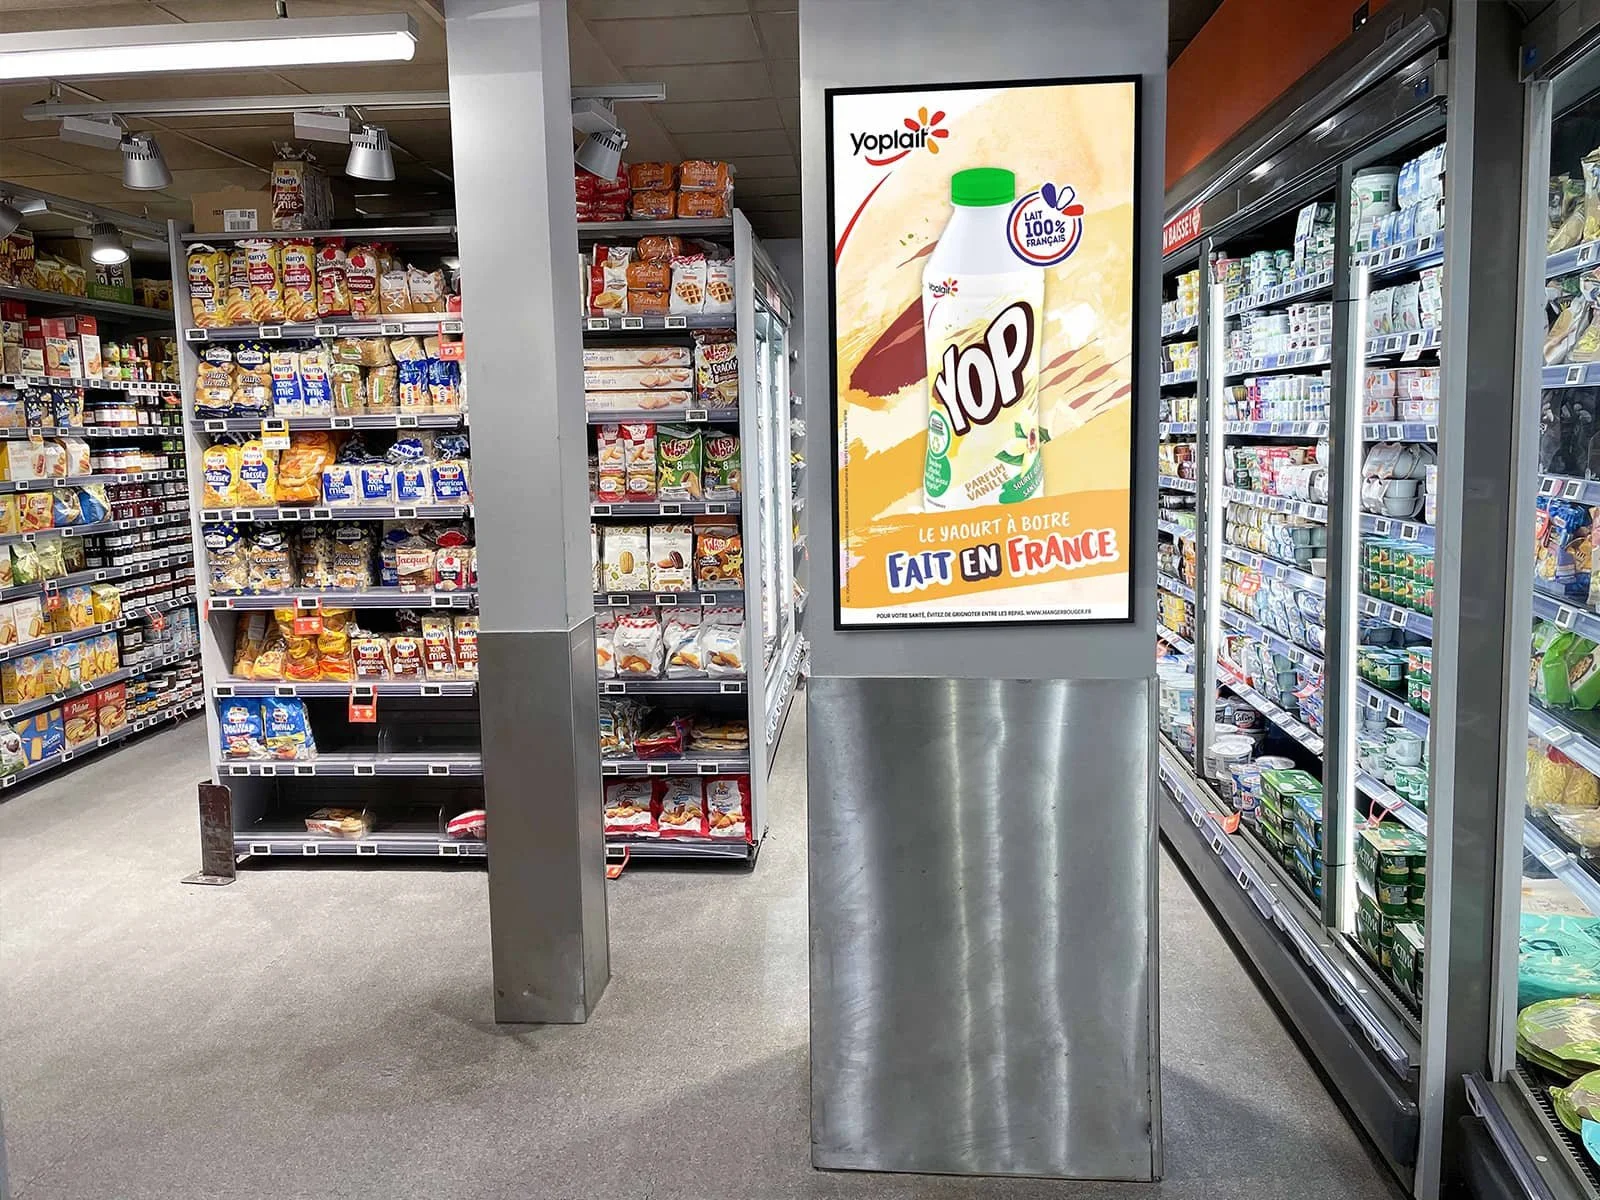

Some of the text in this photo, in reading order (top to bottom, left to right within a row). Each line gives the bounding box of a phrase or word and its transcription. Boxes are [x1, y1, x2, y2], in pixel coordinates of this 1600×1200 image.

[276, 176, 297, 185] Harry's
[1024, 210, 1043, 222] LAIT
[1025, 220, 1066, 238] 100%
[1026, 234, 1066, 248] FRANÇAIS
[16, 243, 35, 260] LION
[936, 302, 1034, 436] YOP
[276, 386, 294, 396] mie
[306, 387, 325, 397] mie
[676, 460, 683, 471] 8
[722, 460, 729, 471] 8
[964, 463, 1006, 493] PARFUM
[367, 484, 385, 492] mie
[967, 472, 1011, 501] VANILLE
[919, 512, 1071, 544] LE YAOURT À BOIRE
[397, 555, 430, 566] Jacquet
[889, 531, 1115, 588] FAIT EN FRANCE
[908, 611, 926, 619] SANTÉ,
[926, 610, 943, 618] ÉVITEZ
[1026, 608, 1092, 616] WWW.MANGERBOUGER.FR
[429, 652, 448, 660] mie
[460, 651, 478, 659] mie
